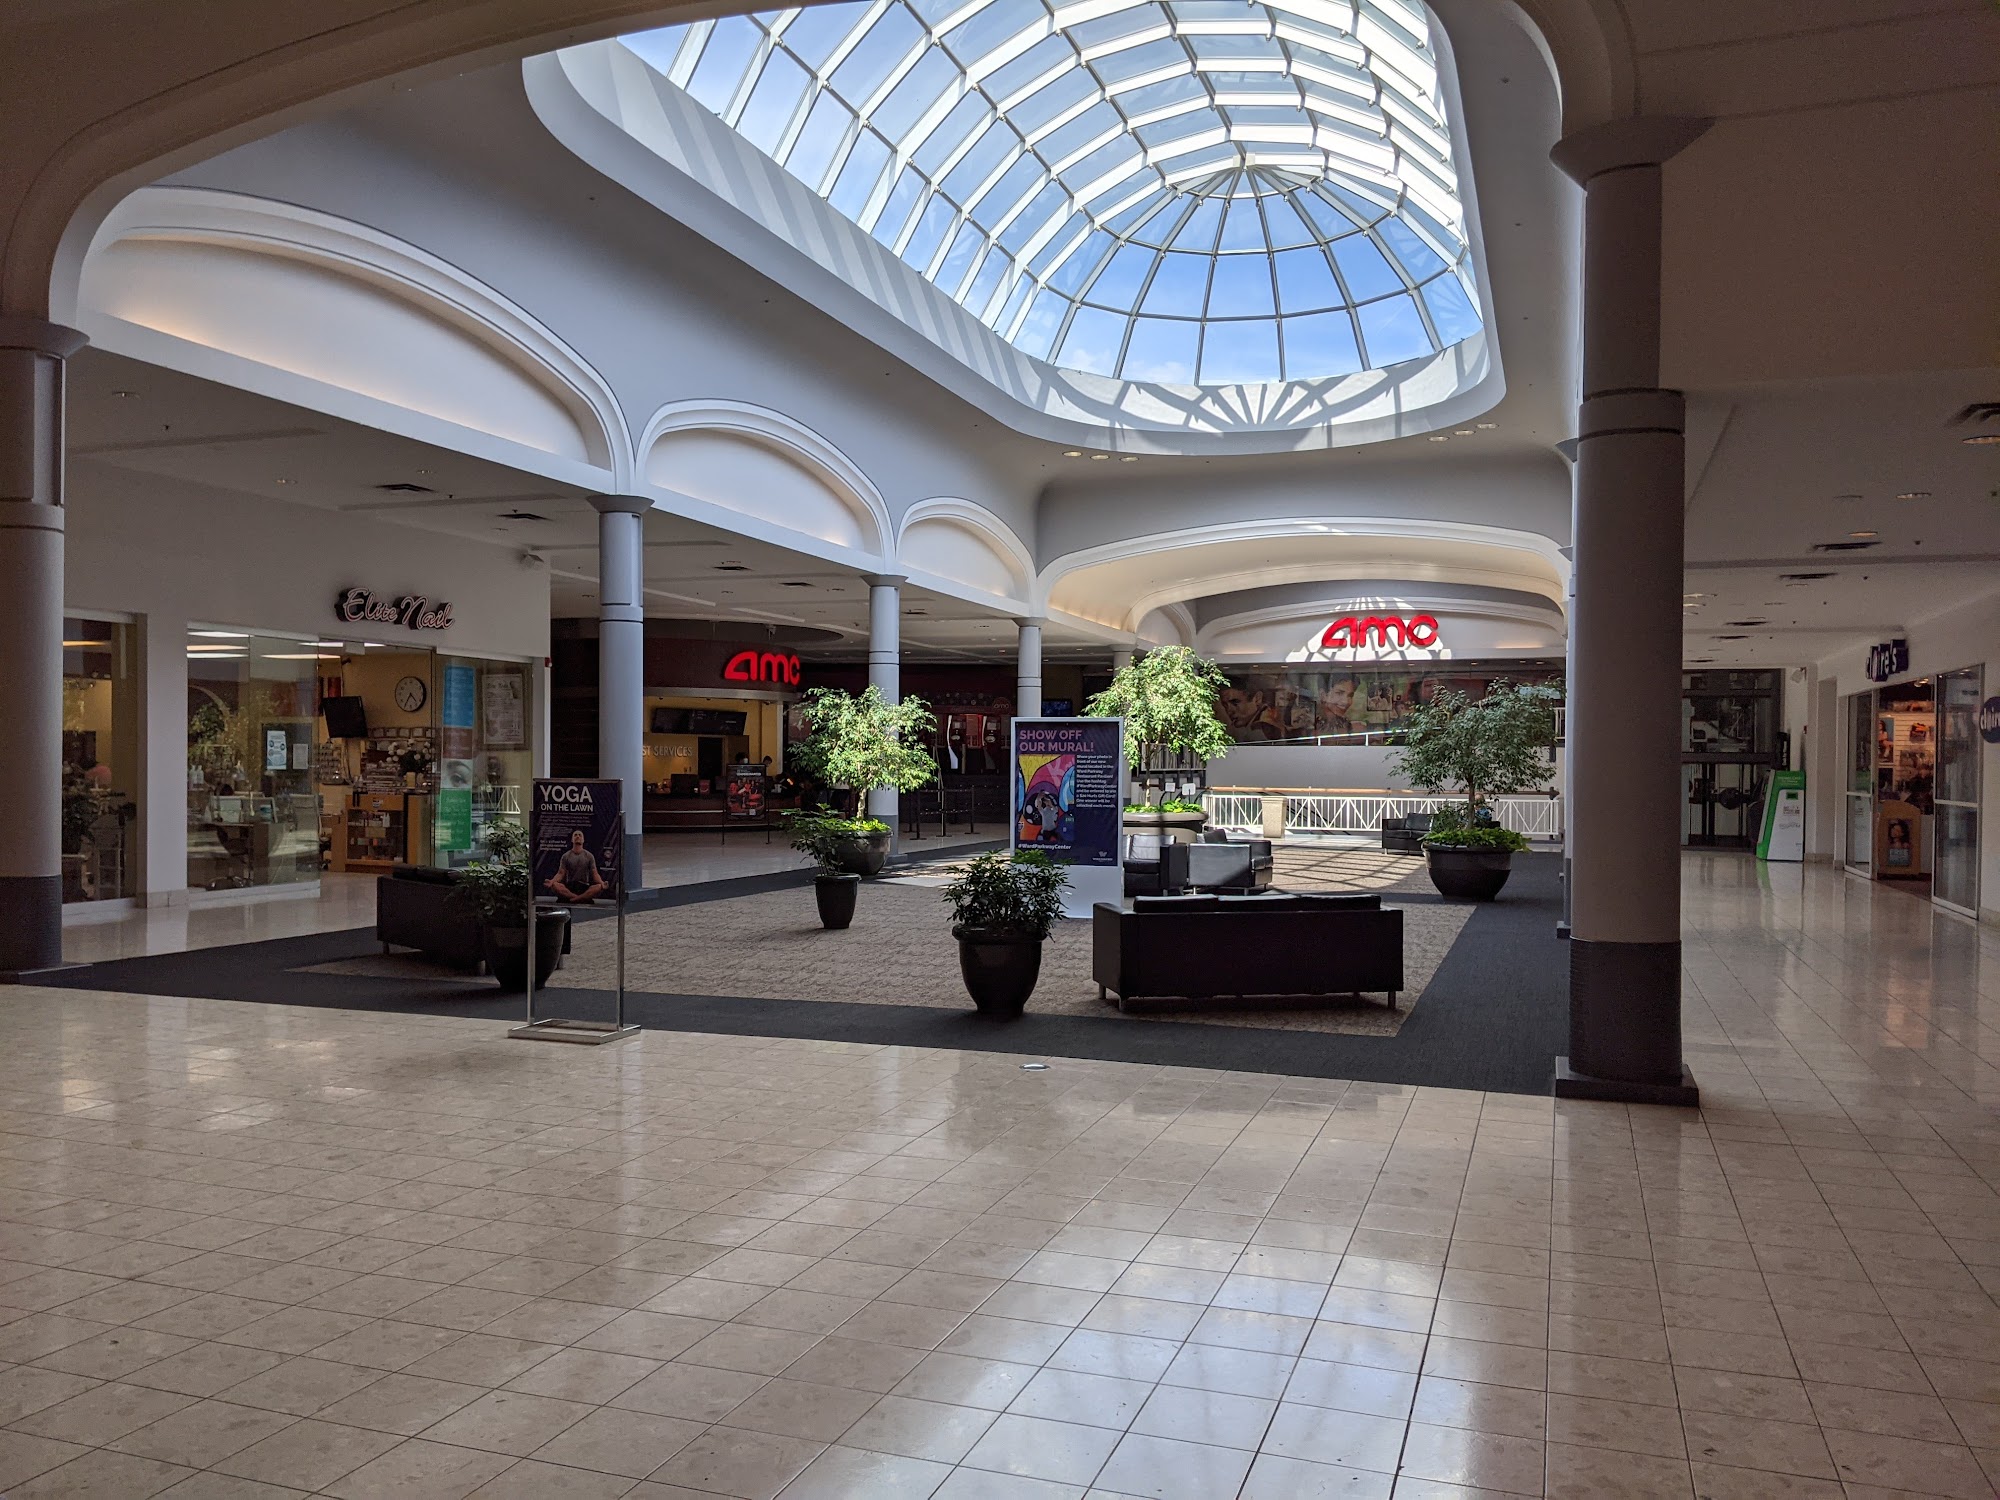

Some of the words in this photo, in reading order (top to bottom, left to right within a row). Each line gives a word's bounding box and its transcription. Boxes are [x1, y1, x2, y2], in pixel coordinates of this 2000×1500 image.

[342, 587, 399, 622] Elite
[400, 596, 455, 630] Nail
[1020, 729, 1057, 740] SHOW
[1059, 729, 1083, 740] OFF
[653, 745, 693, 758] SERVICES
[1019, 741, 1046, 752] OUR
[1048, 741, 1094, 752] MURAL!
[540, 785, 593, 803] YOGA
[540, 803, 553, 811] ON
[553, 803, 569, 812] THE
[570, 804, 594, 812] LAWN
